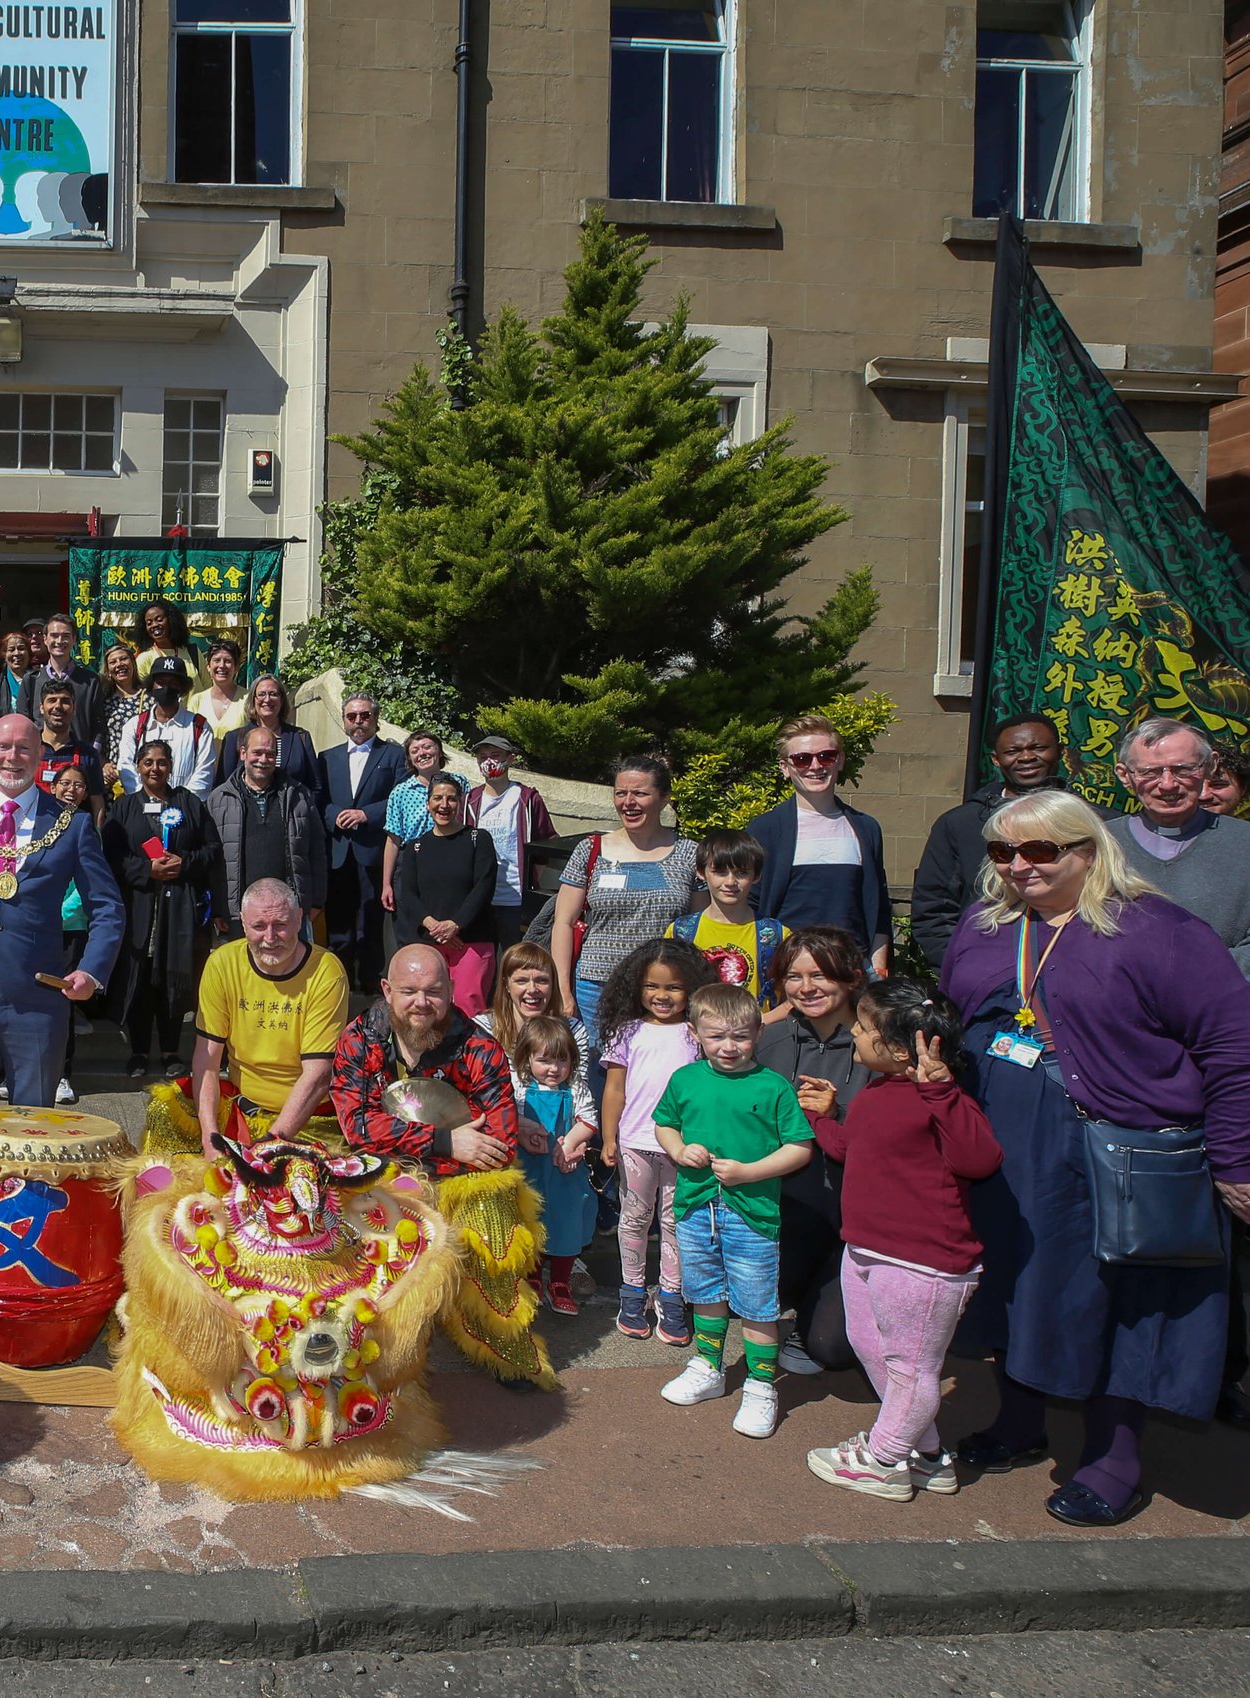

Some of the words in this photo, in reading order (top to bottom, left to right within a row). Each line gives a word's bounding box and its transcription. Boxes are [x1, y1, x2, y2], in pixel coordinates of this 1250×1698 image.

[107, 565, 246, 589] 歐洲洪佛總會
[108, 591, 138, 601] HUNG
[140, 592, 161, 602] FUT
